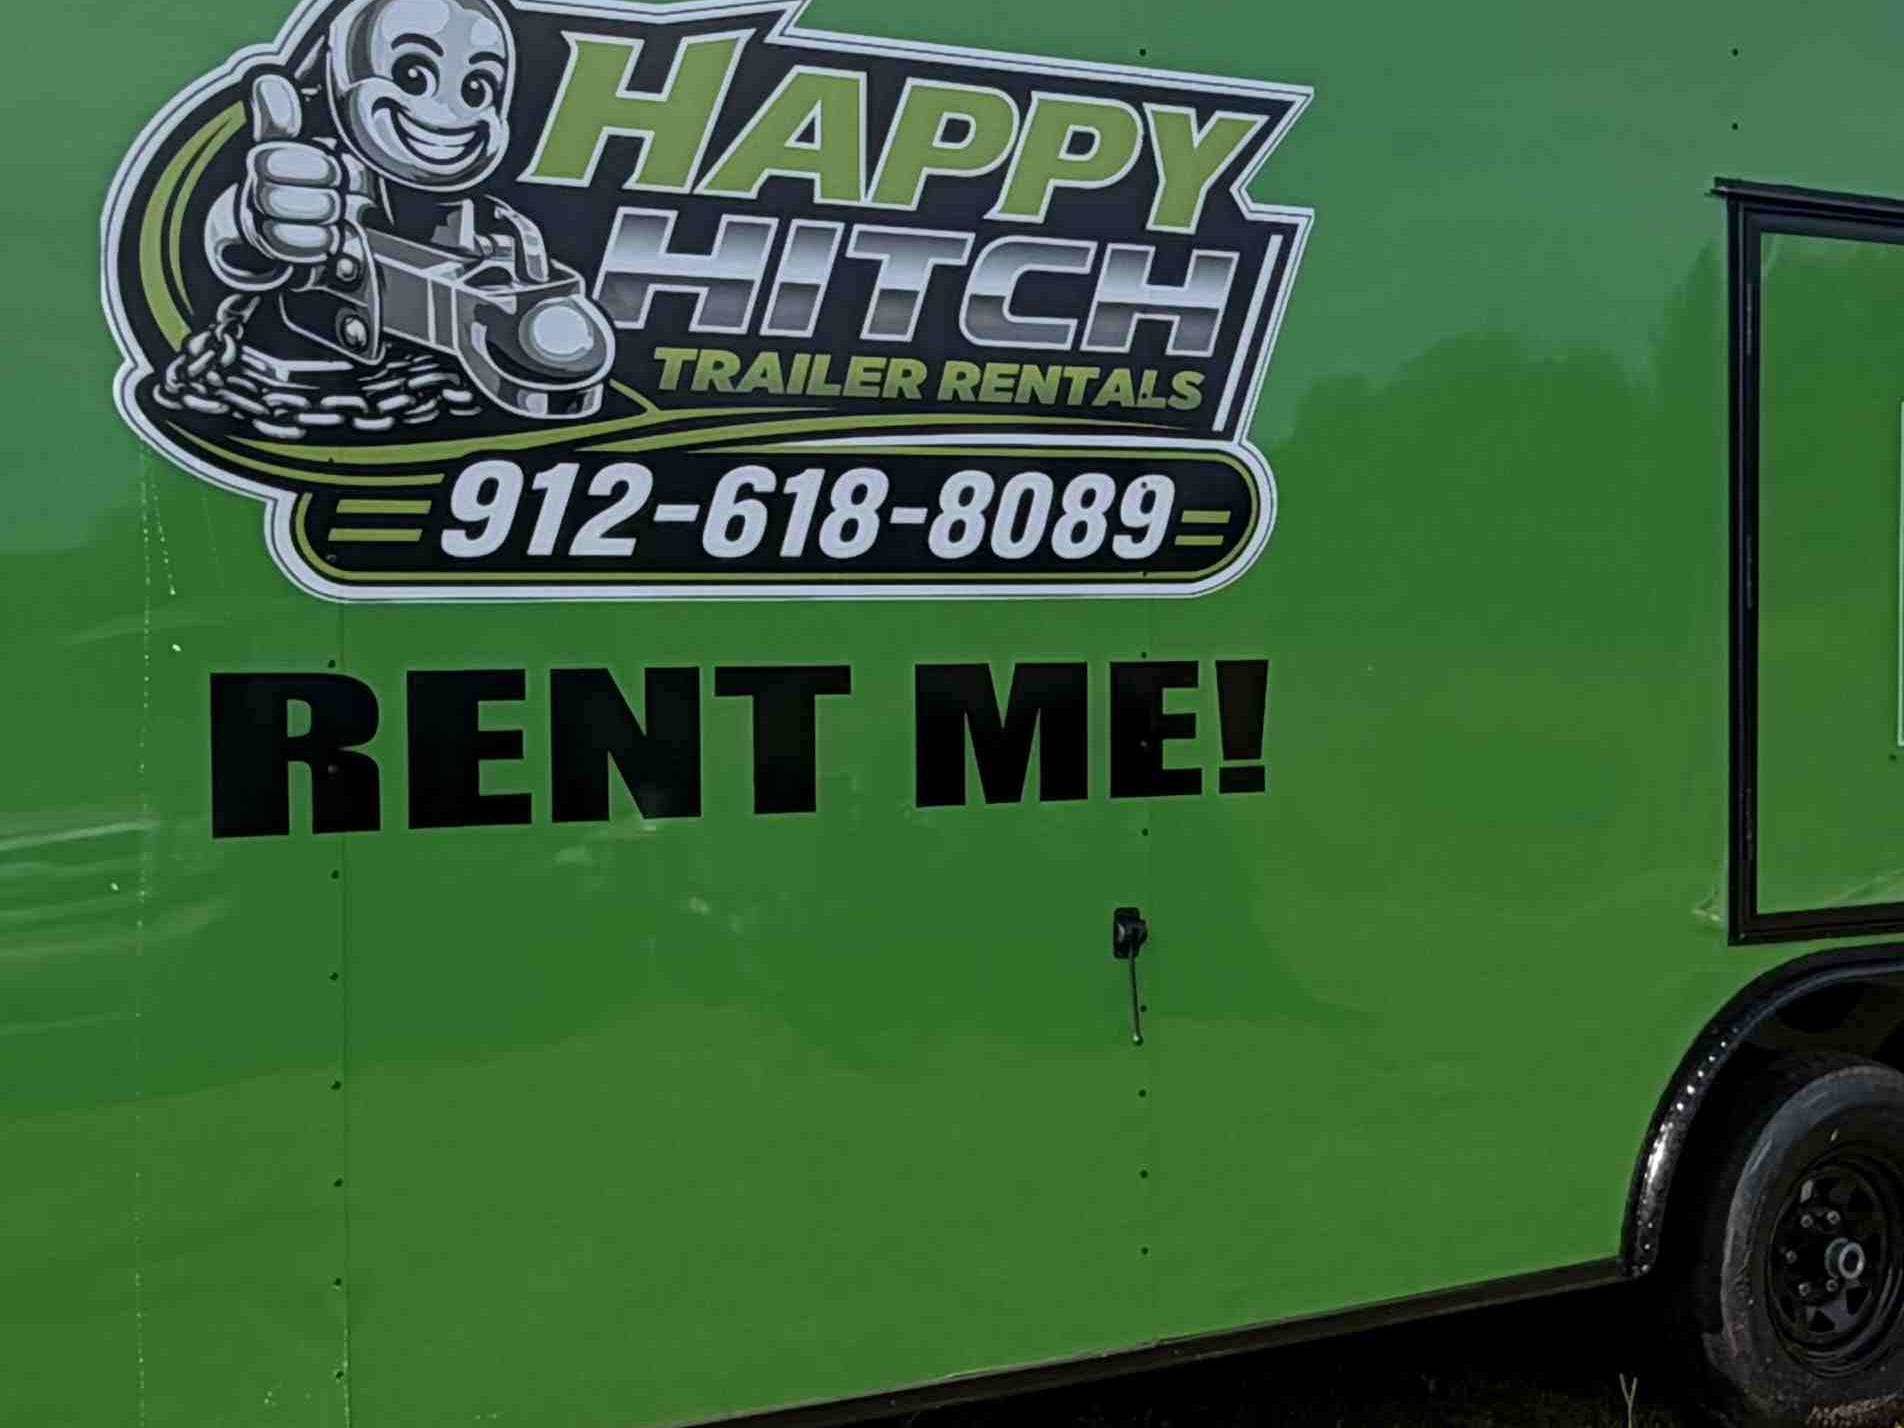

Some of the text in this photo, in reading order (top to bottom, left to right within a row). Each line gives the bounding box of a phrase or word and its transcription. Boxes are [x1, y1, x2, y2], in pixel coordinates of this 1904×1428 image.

[518, 28, 1270, 235] HAPPY
[596, 208, 1241, 357] HITCH
[654, 347, 1205, 412] TRAILER RENTALS
[439, 461, 1176, 562] 912-618-8089
[209, 658, 1270, 839] RENT ME!
